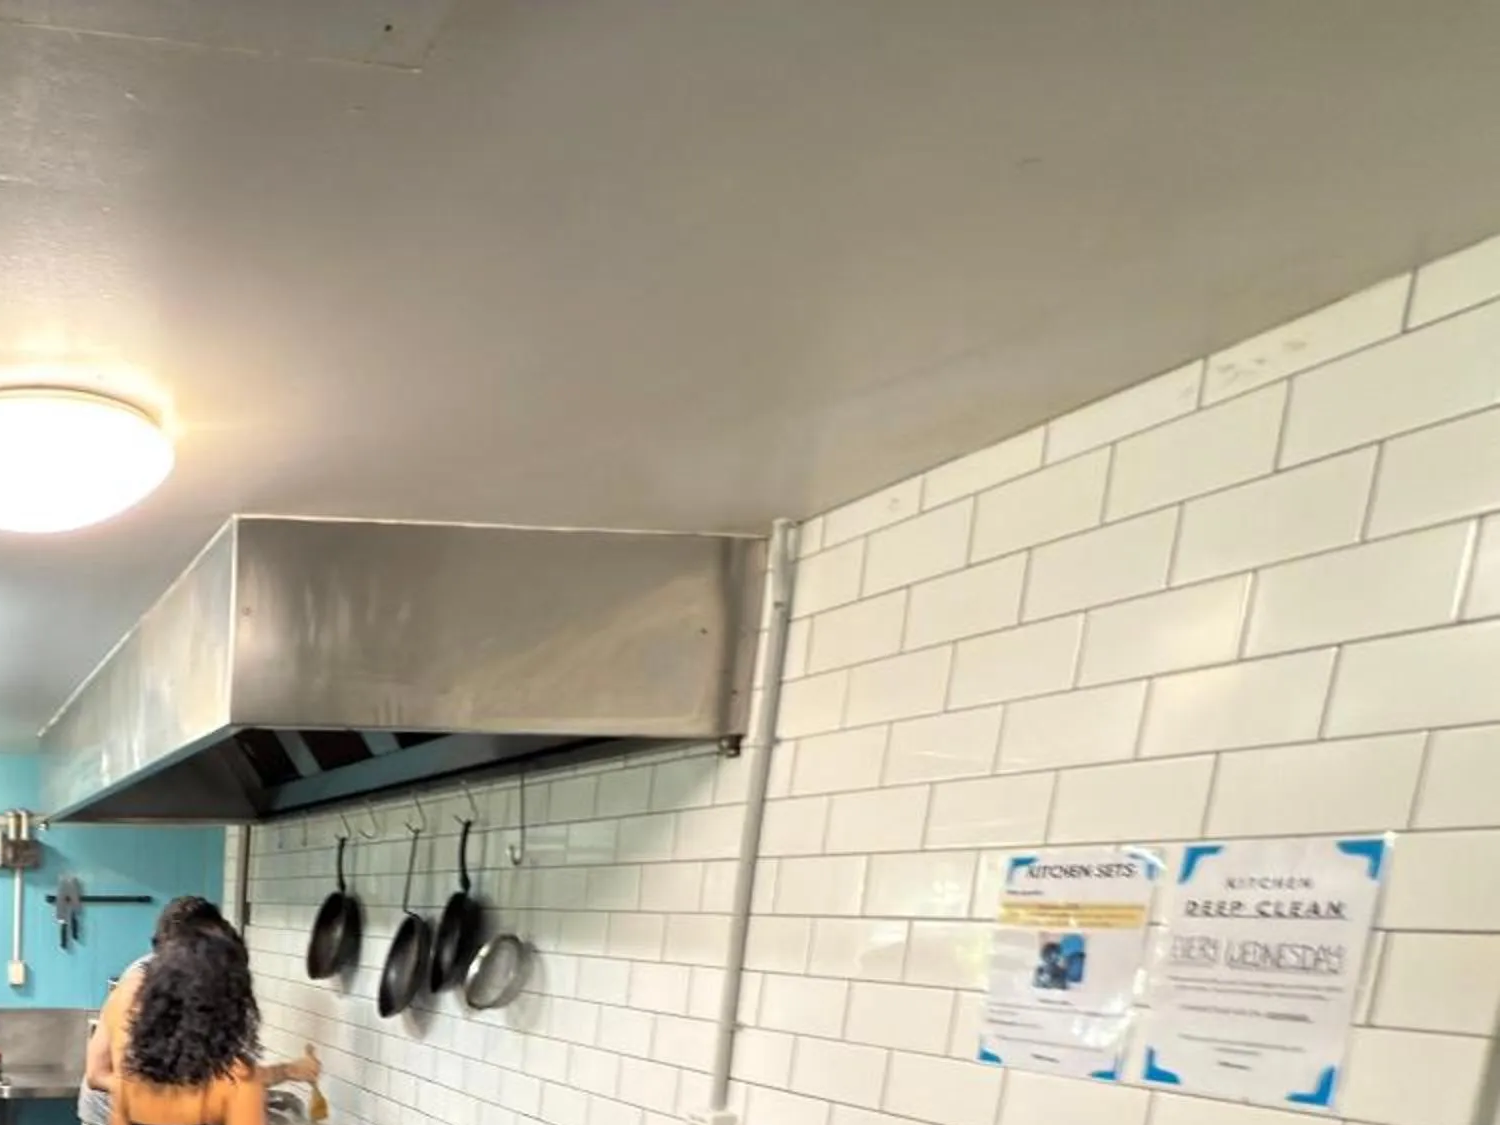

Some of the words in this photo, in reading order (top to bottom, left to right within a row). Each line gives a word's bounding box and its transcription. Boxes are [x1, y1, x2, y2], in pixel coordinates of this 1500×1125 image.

[1025, 864, 1092, 880] KITCHEN
[1095, 863, 1138, 879] SETS
[1255, 901, 1349, 919] CLEAN
